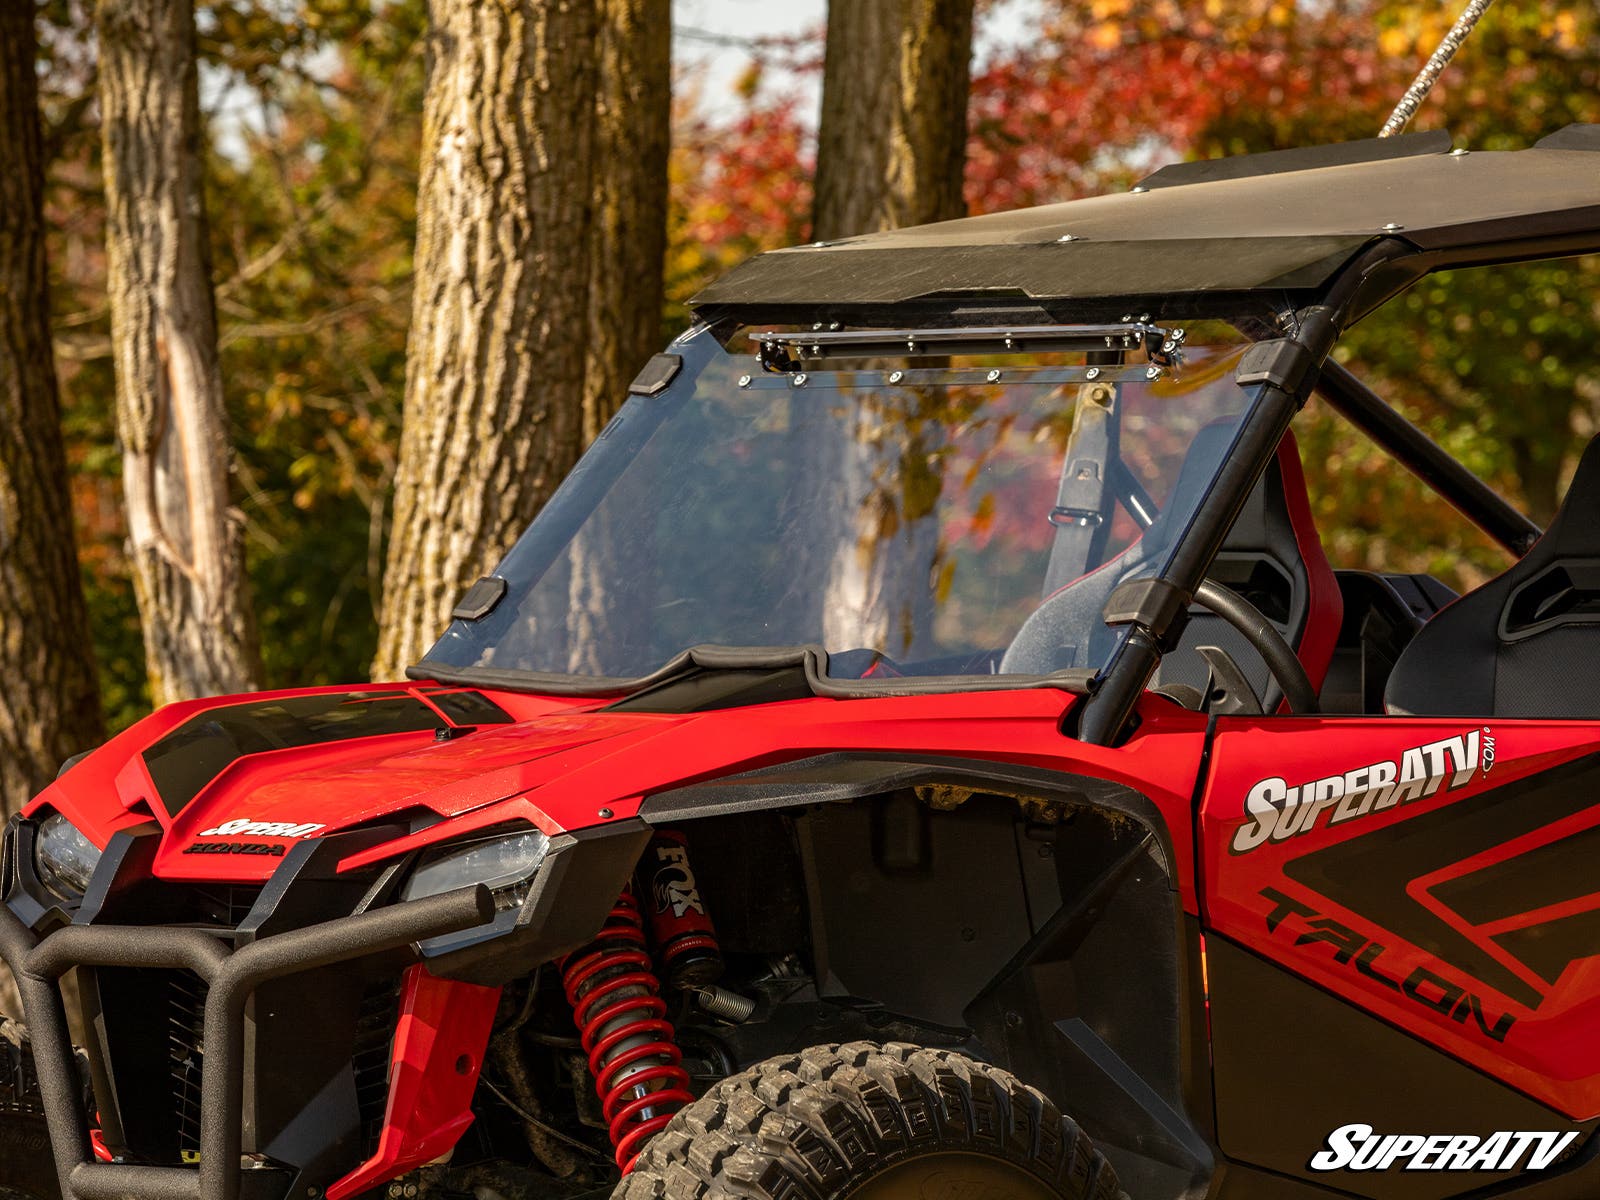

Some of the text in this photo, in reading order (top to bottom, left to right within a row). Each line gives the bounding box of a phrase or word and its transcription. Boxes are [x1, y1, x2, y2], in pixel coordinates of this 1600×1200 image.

[1232, 729, 1481, 853] SUPERATV
[182, 842, 287, 857] HONDA
[653, 846, 704, 918] FOX
[1257, 886, 1518, 1043] TALON
